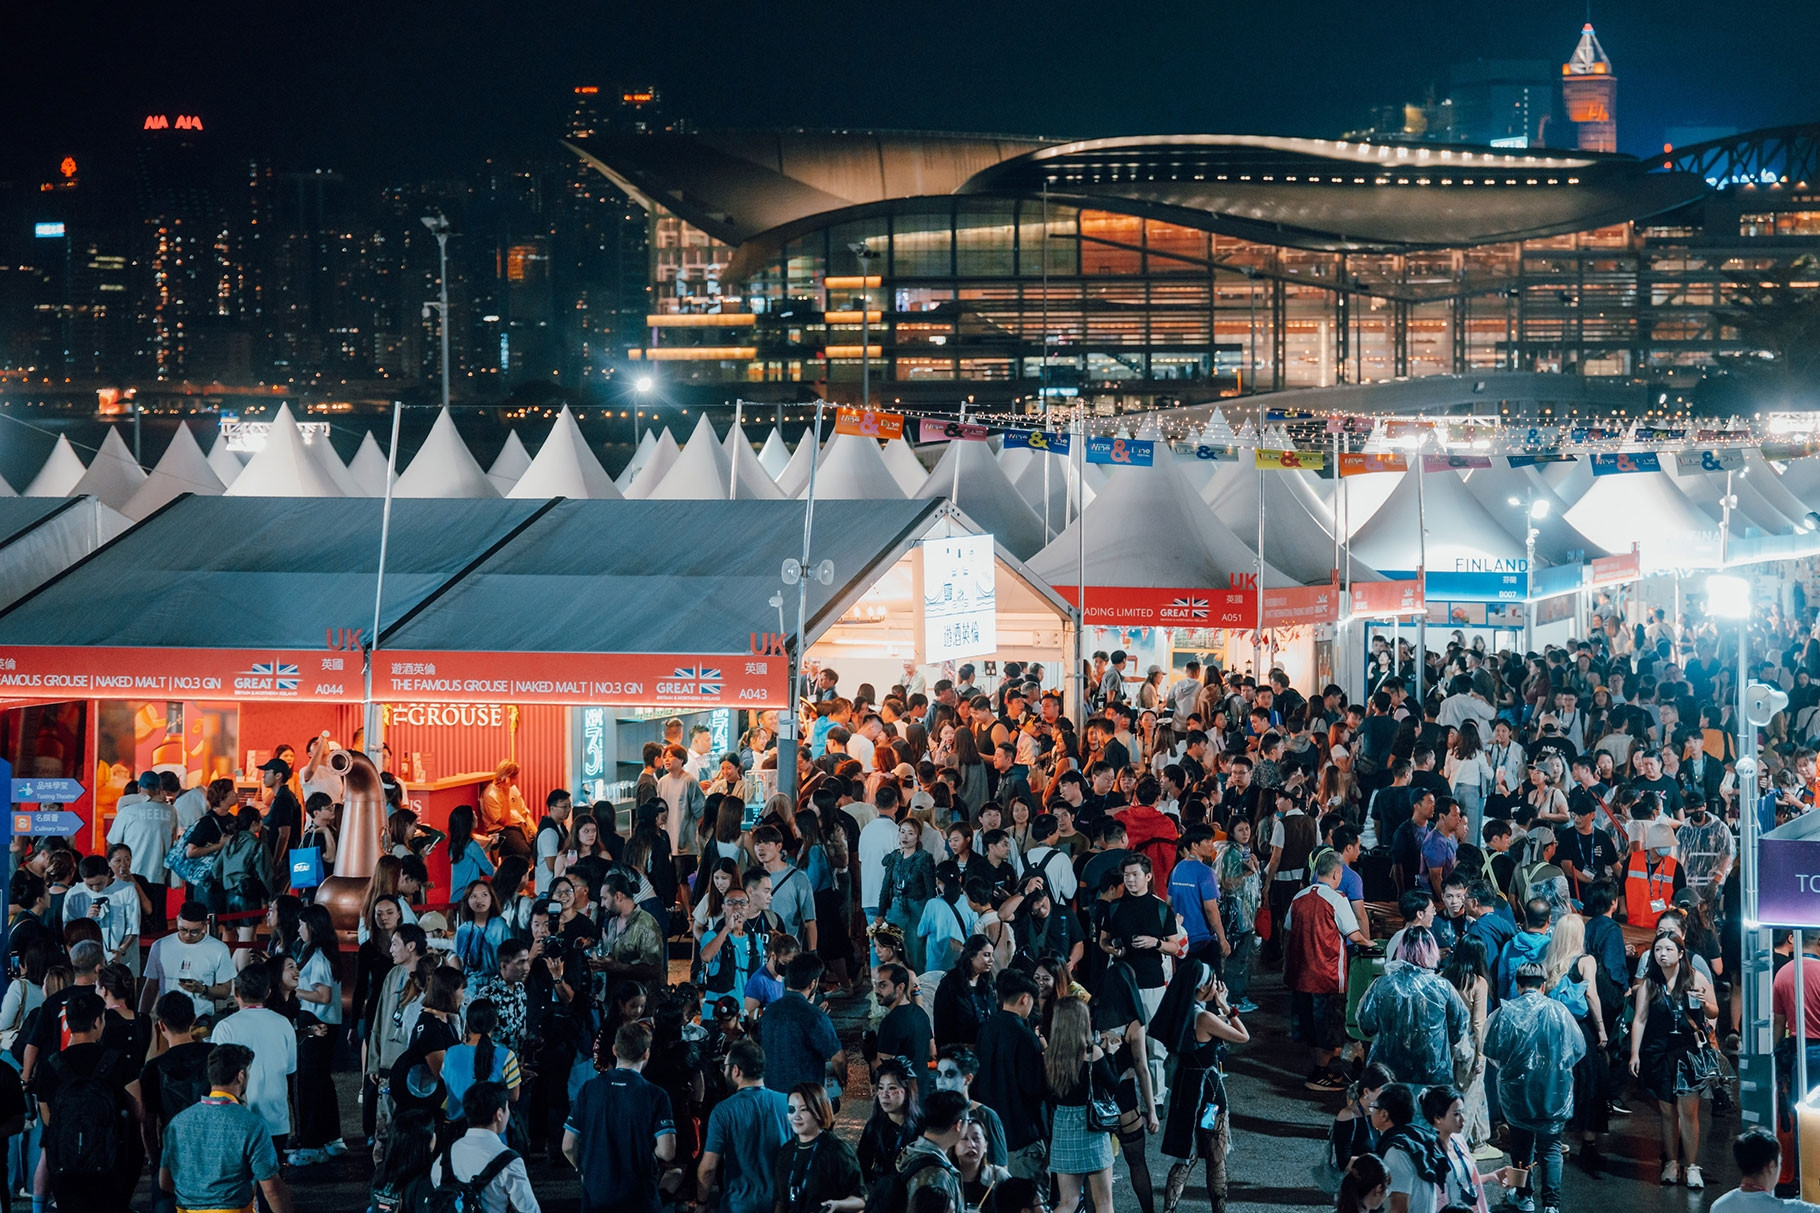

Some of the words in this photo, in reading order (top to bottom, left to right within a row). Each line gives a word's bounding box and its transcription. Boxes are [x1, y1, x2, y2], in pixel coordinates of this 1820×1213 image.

[144, 115, 168, 130] AIA
[175, 114, 203, 130] AIA
[860, 412, 879, 435] &
[944, 422, 965, 438] &
[1028, 432, 1049, 449] &
[1111, 439, 1131, 463] &
[1196, 445, 1218, 460] &
[1280, 451, 1302, 468] &
[1617, 453, 1639, 471] &
[1702, 450, 1724, 471] &
[1456, 558, 1528, 572] FINLAND
[1229, 572, 1257, 590] UK
[1226, 594, 1243, 604] 英國
[1117, 608, 1154, 618] LIMITED
[1160, 609, 1190, 617] GREAT
[1222, 613, 1242, 622] A051
[326, 628, 364, 650] UK
[750, 632, 788, 656] UK
[321, 658, 343, 671] 英國
[391, 663, 435, 675] 遊酒英倫
[745, 662, 768, 675] 英國
[0, 674, 42, 686] AMOUS
[44, 675, 88, 687] GROUSE
[95, 676, 133, 688] NAKED
[135, 677, 166, 688] MALT
[174, 677, 200, 689] NO.3
[202, 677, 222, 689] GIN
[234, 678, 273, 690] GREAT
[391, 679, 412, 691] THE
[414, 679, 461, 691] FAMOUS
[463, 680, 508, 692] GROUSE
[516, 681, 553, 692] NAKED
[555, 681, 587, 693] MALT
[595, 682, 621, 694] NO.3
[624, 682, 643, 694] GIN
[656, 682, 696, 694] GREAT
[315, 684, 343, 695] A044
[739, 688, 768, 700] A043
[408, 707, 502, 727] GROUSE
[139, 808, 171, 821] HEELS
